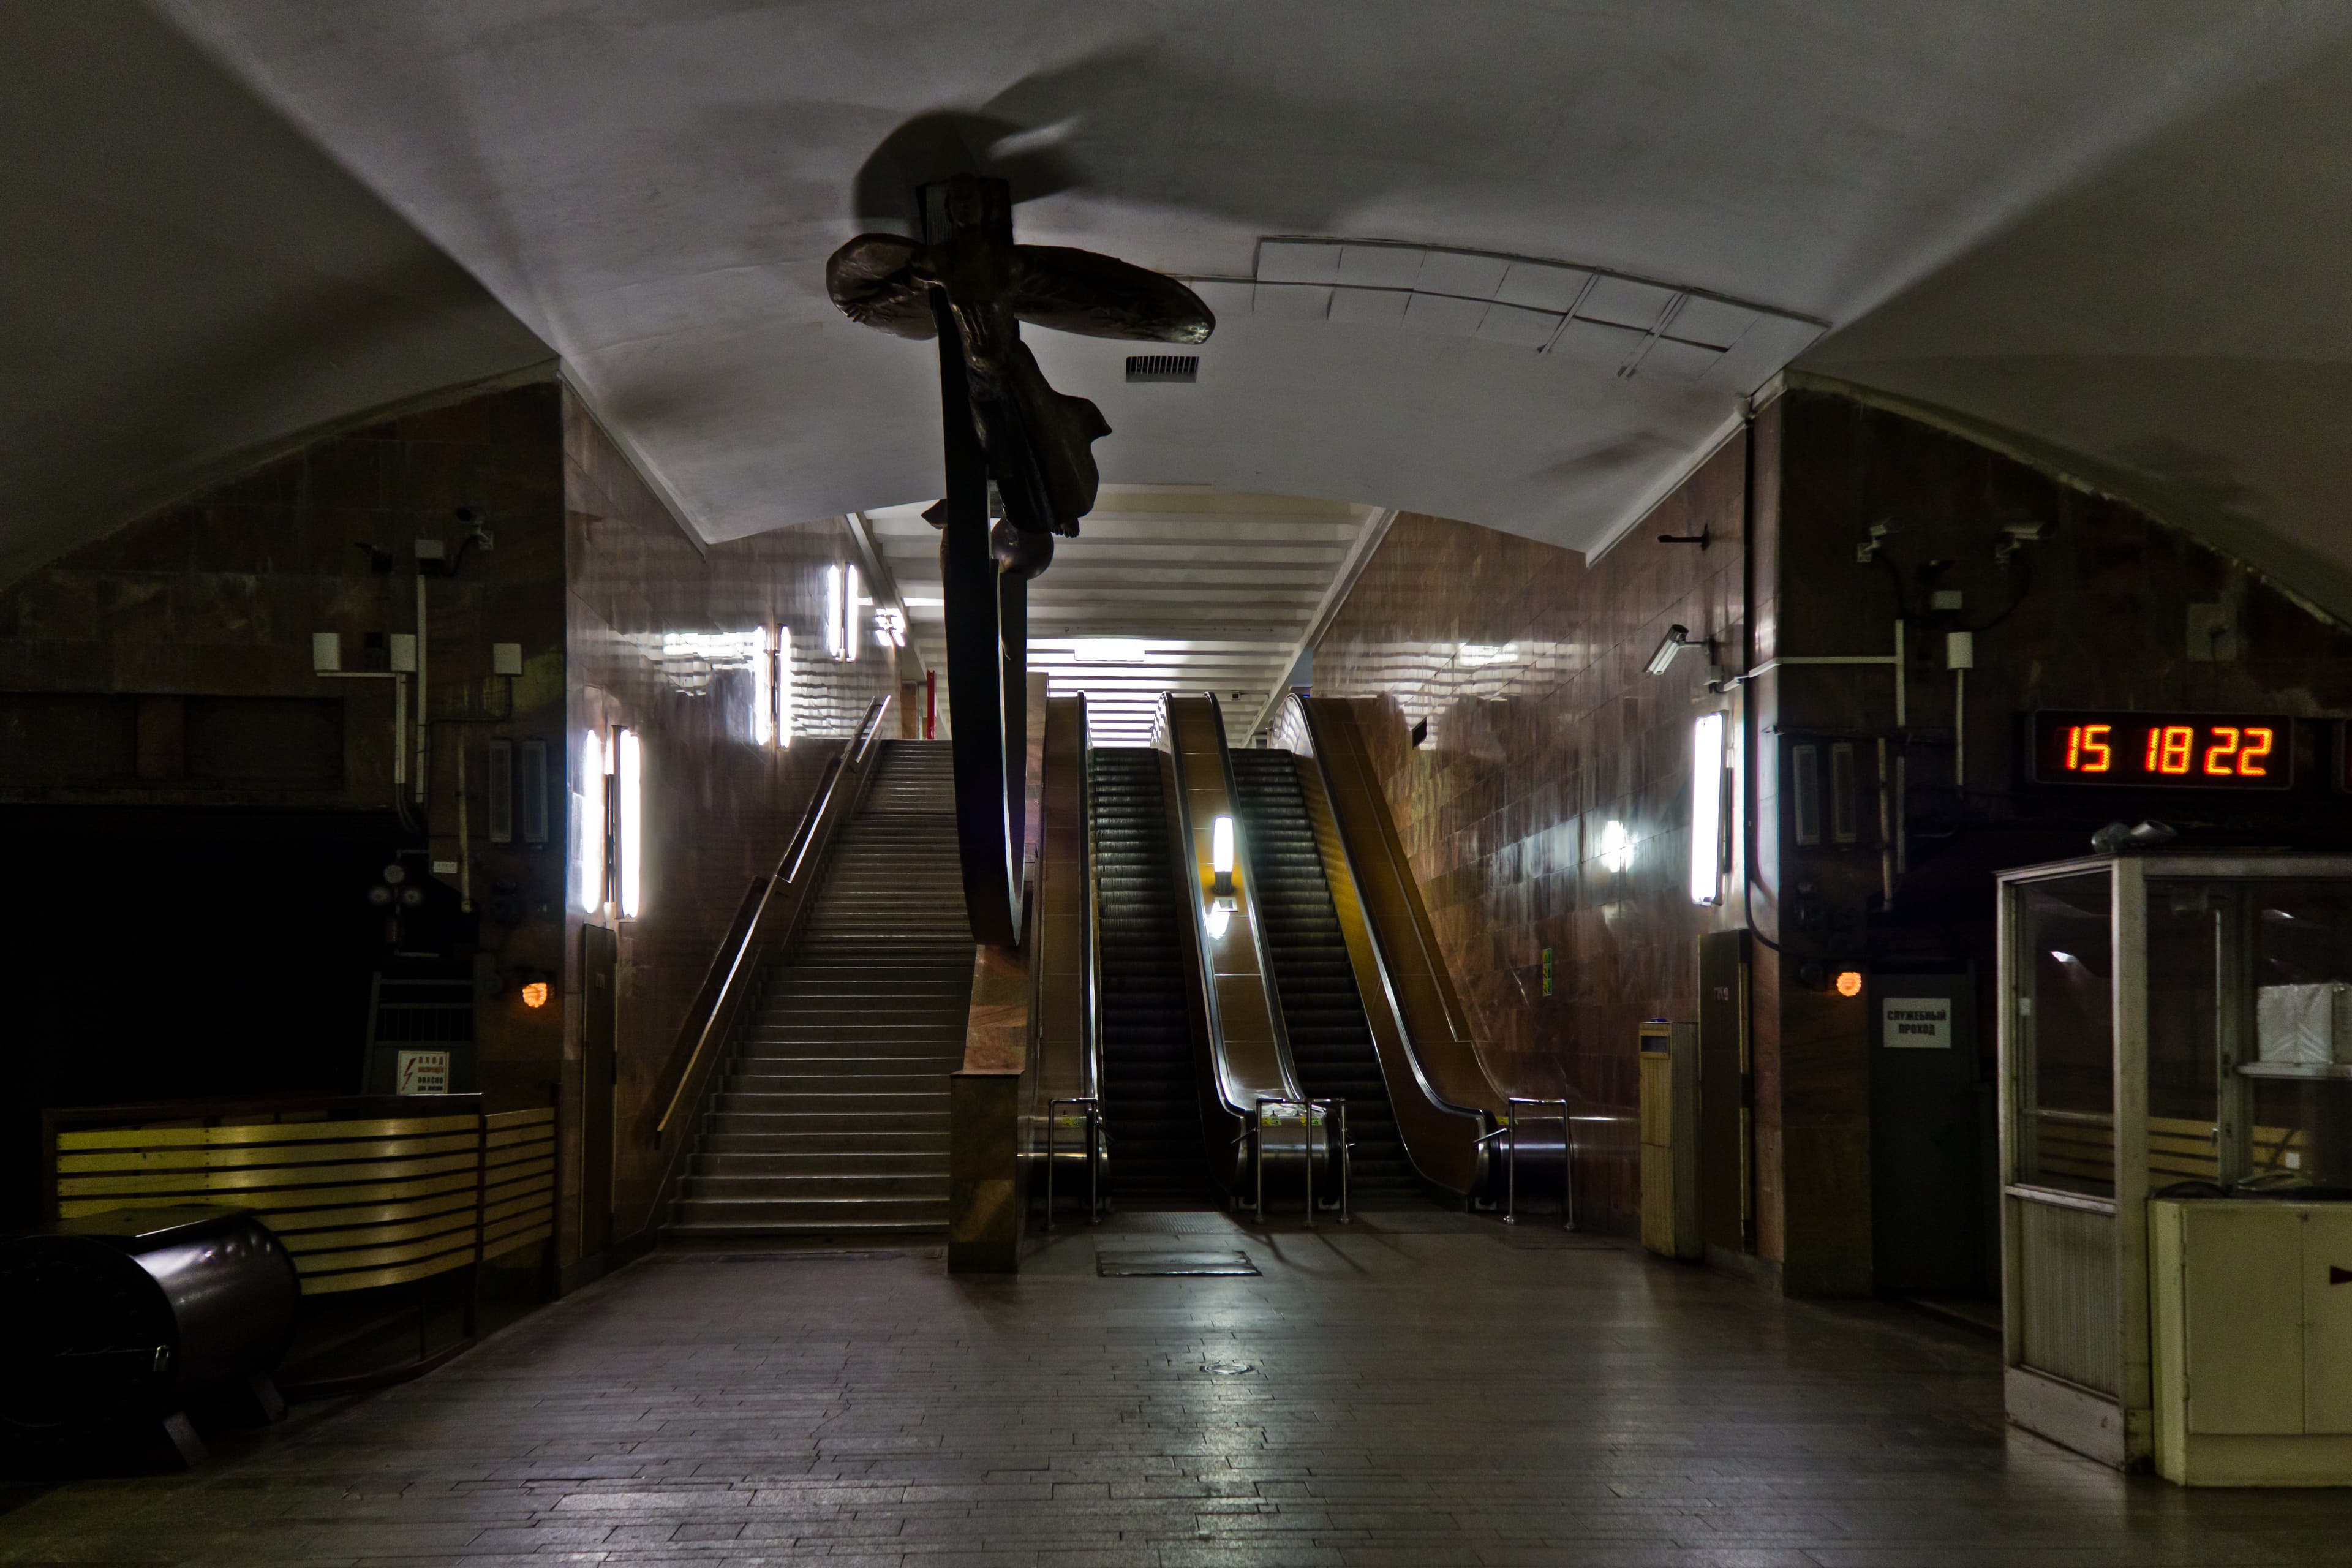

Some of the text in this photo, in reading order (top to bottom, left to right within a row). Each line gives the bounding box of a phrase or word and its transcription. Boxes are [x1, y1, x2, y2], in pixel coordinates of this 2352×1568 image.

[2066, 725, 2272, 776] 15 18 22
[1887, 1009, 1947, 1021] СЛУЖЕБНЫЙ
[1898, 1023, 1936, 1036] ПРОХОД
